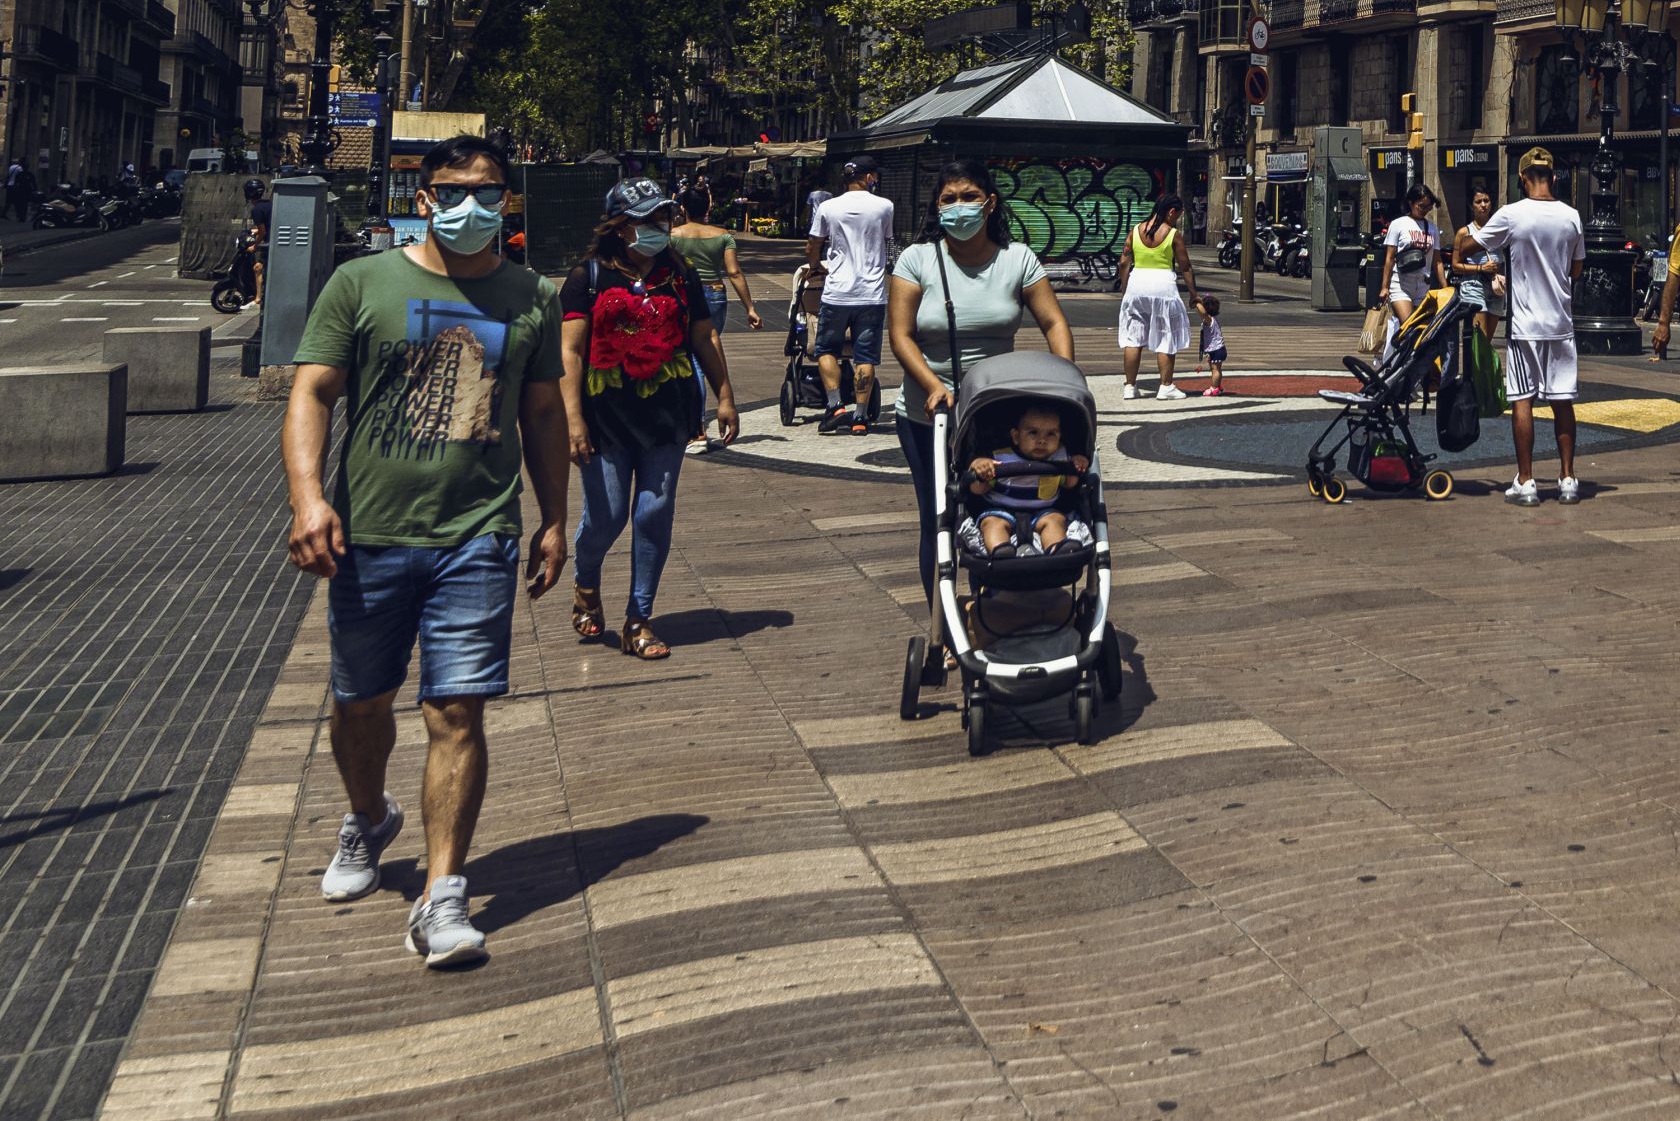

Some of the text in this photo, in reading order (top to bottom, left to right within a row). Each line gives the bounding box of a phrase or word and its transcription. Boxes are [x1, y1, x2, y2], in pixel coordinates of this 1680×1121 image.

[1384, 151, 1402, 168] pans
[1455, 149, 1474, 167] pans
[1647, 167, 1661, 178] BBV
[379, 339, 463, 360] POWER
[377, 358, 460, 378] POWER
[376, 375, 458, 396] POWER
[374, 391, 454, 413] POWER
[371, 409, 452, 430] POWER
[368, 426, 449, 460] POWER
